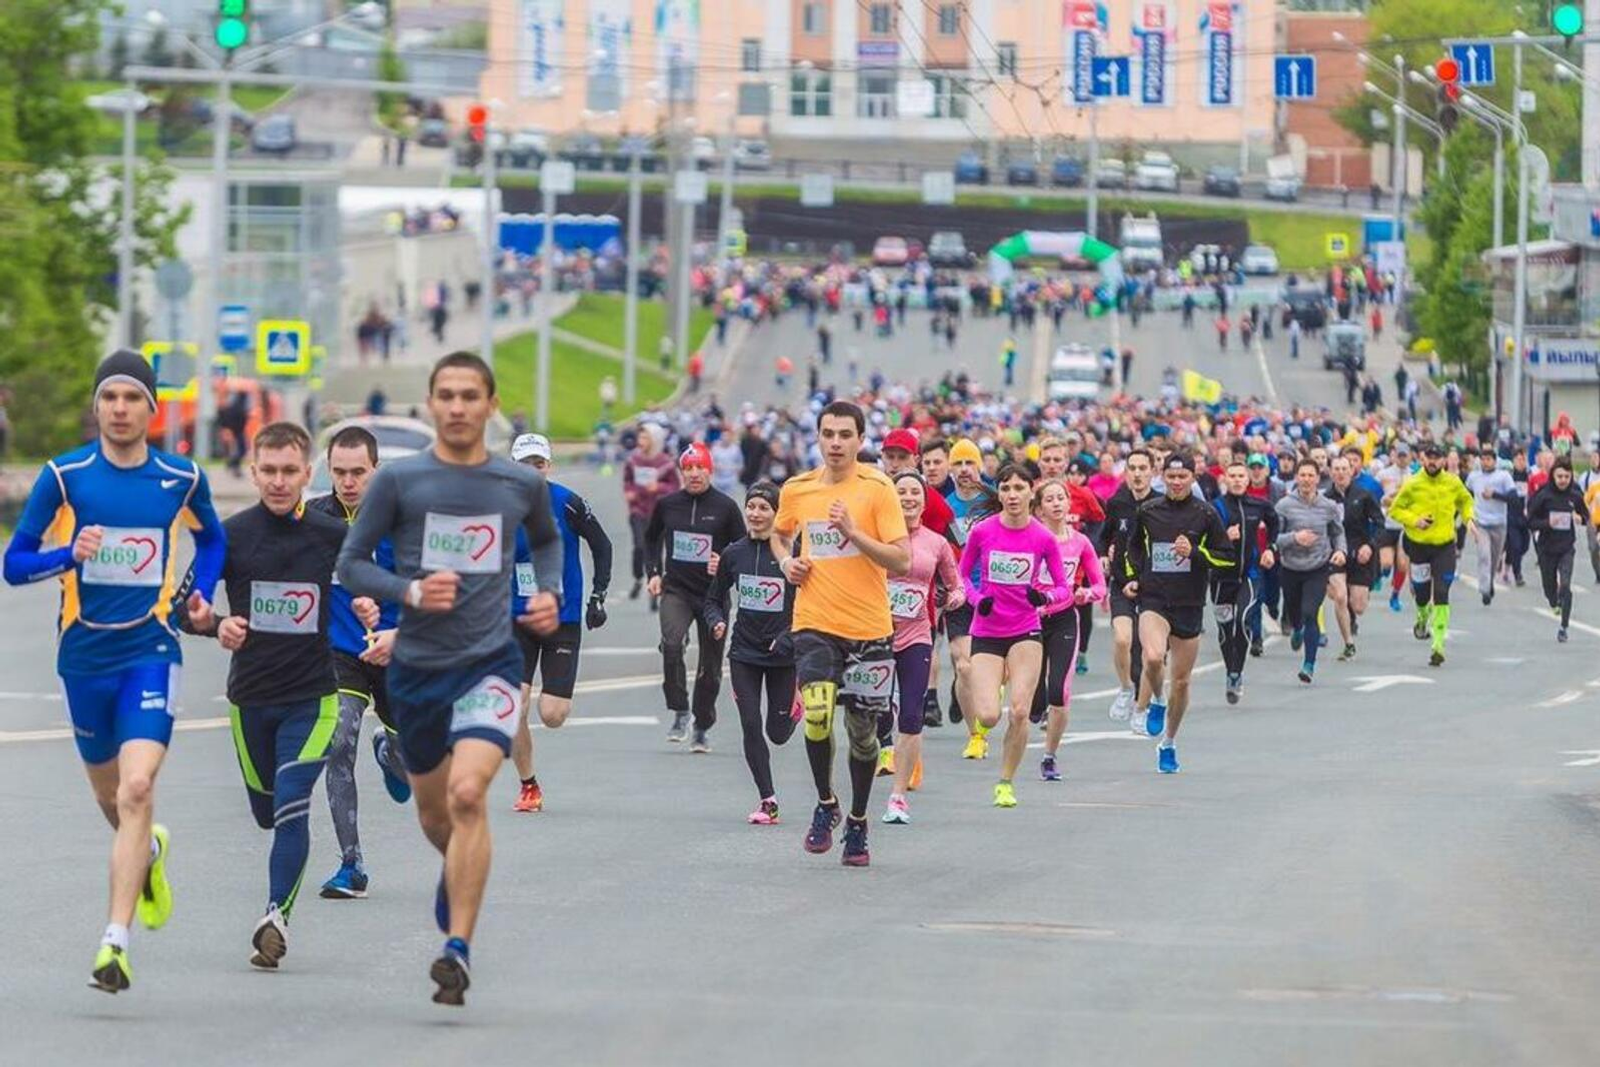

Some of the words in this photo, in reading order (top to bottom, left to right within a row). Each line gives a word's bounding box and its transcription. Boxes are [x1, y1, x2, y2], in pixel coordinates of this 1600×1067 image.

[428, 531, 476, 554] 0627
[809, 531, 841, 546] 1933
[990, 560, 1020, 574] 0652
[519, 573, 538, 585] 03
[740, 585, 768, 599] 0851
[253, 597, 299, 616] 0679
